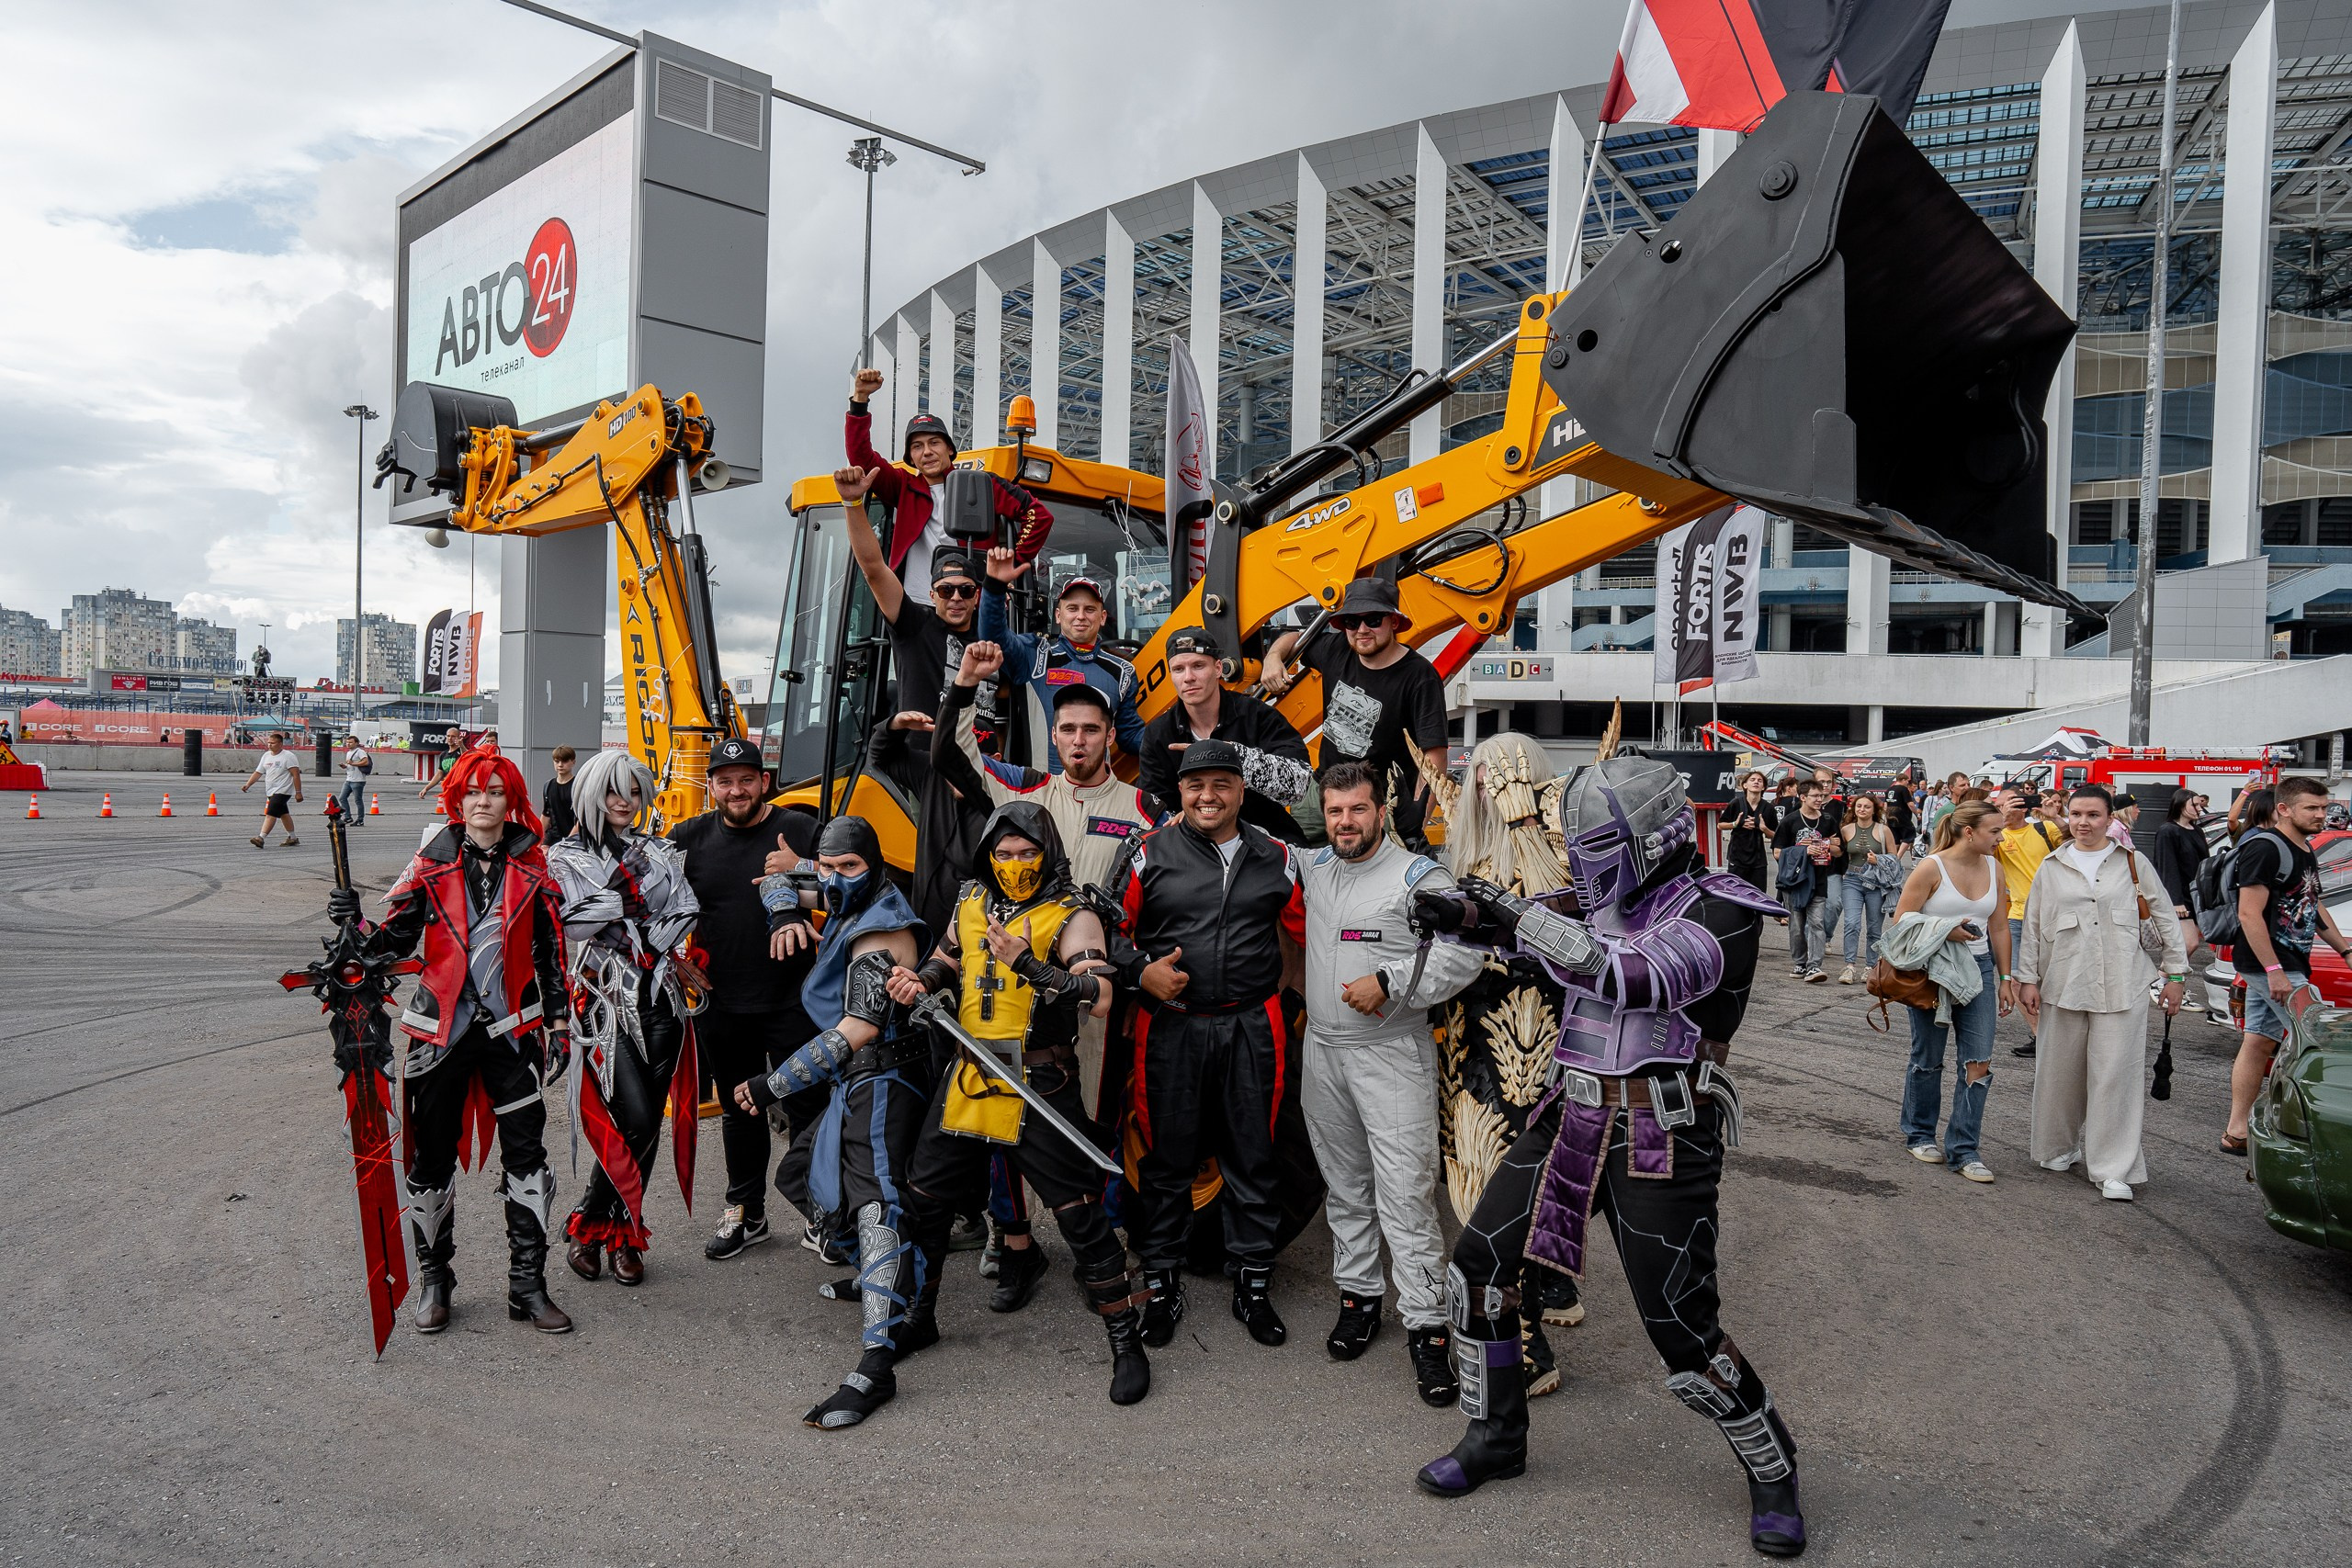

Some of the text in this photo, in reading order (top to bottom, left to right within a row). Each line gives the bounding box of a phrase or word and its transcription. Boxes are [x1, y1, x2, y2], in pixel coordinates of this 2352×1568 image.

[435, 243, 570, 377] АВТО 24
[481, 356, 525, 383] телеканал
[1286, 497, 1351, 533] 4WD
[1686, 543, 1715, 641] FORTIS
[1724, 534, 1748, 642] NWB
[428, 627, 445, 676] FORTIS
[447, 625, 461, 676] NWB
[1485, 660, 1539, 678] B A D C
[164, 680, 178, 688] ГОШ
[630, 634, 659, 781] RIGOR
